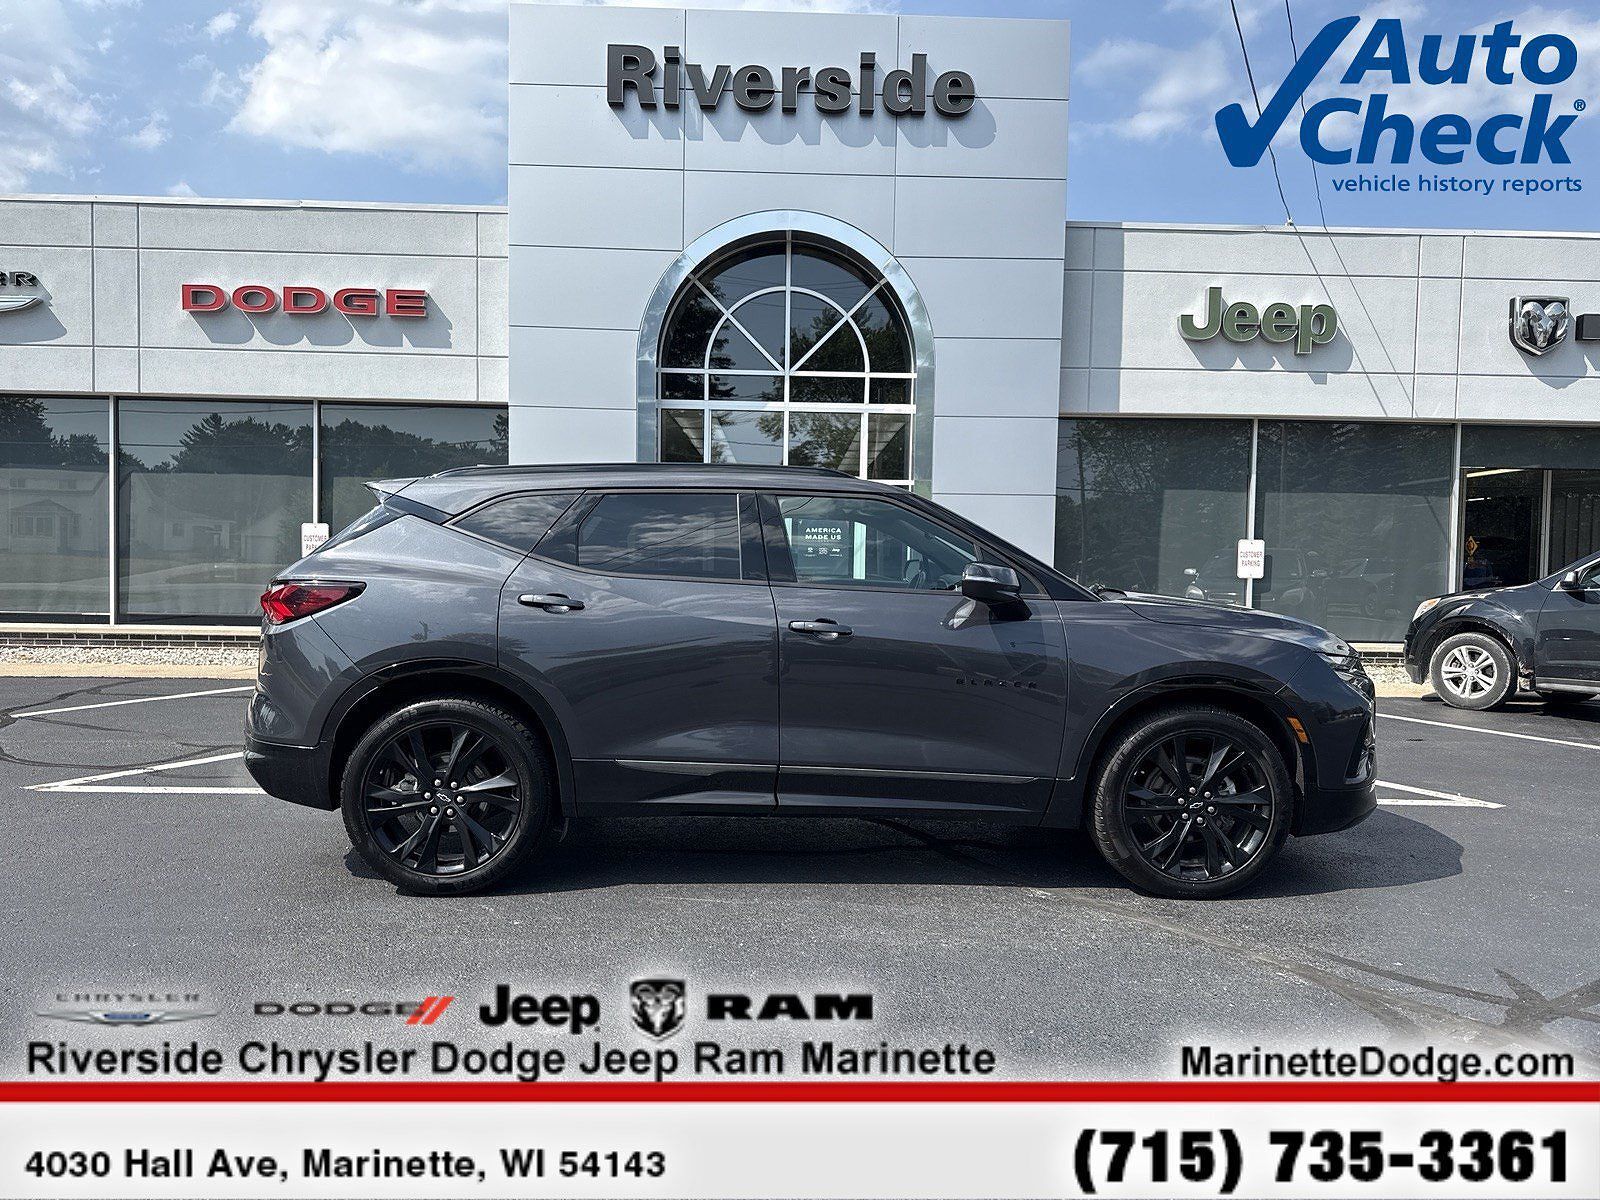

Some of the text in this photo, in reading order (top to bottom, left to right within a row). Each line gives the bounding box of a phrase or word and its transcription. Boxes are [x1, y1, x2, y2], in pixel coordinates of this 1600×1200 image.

[606, 43, 977, 117] Riverside
[181, 283, 429, 319] DODGE
[1177, 286, 1338, 356] Jeep
[1239, 550, 1264, 559] CUSTOMER
[1241, 559, 1261, 567] PARKING
